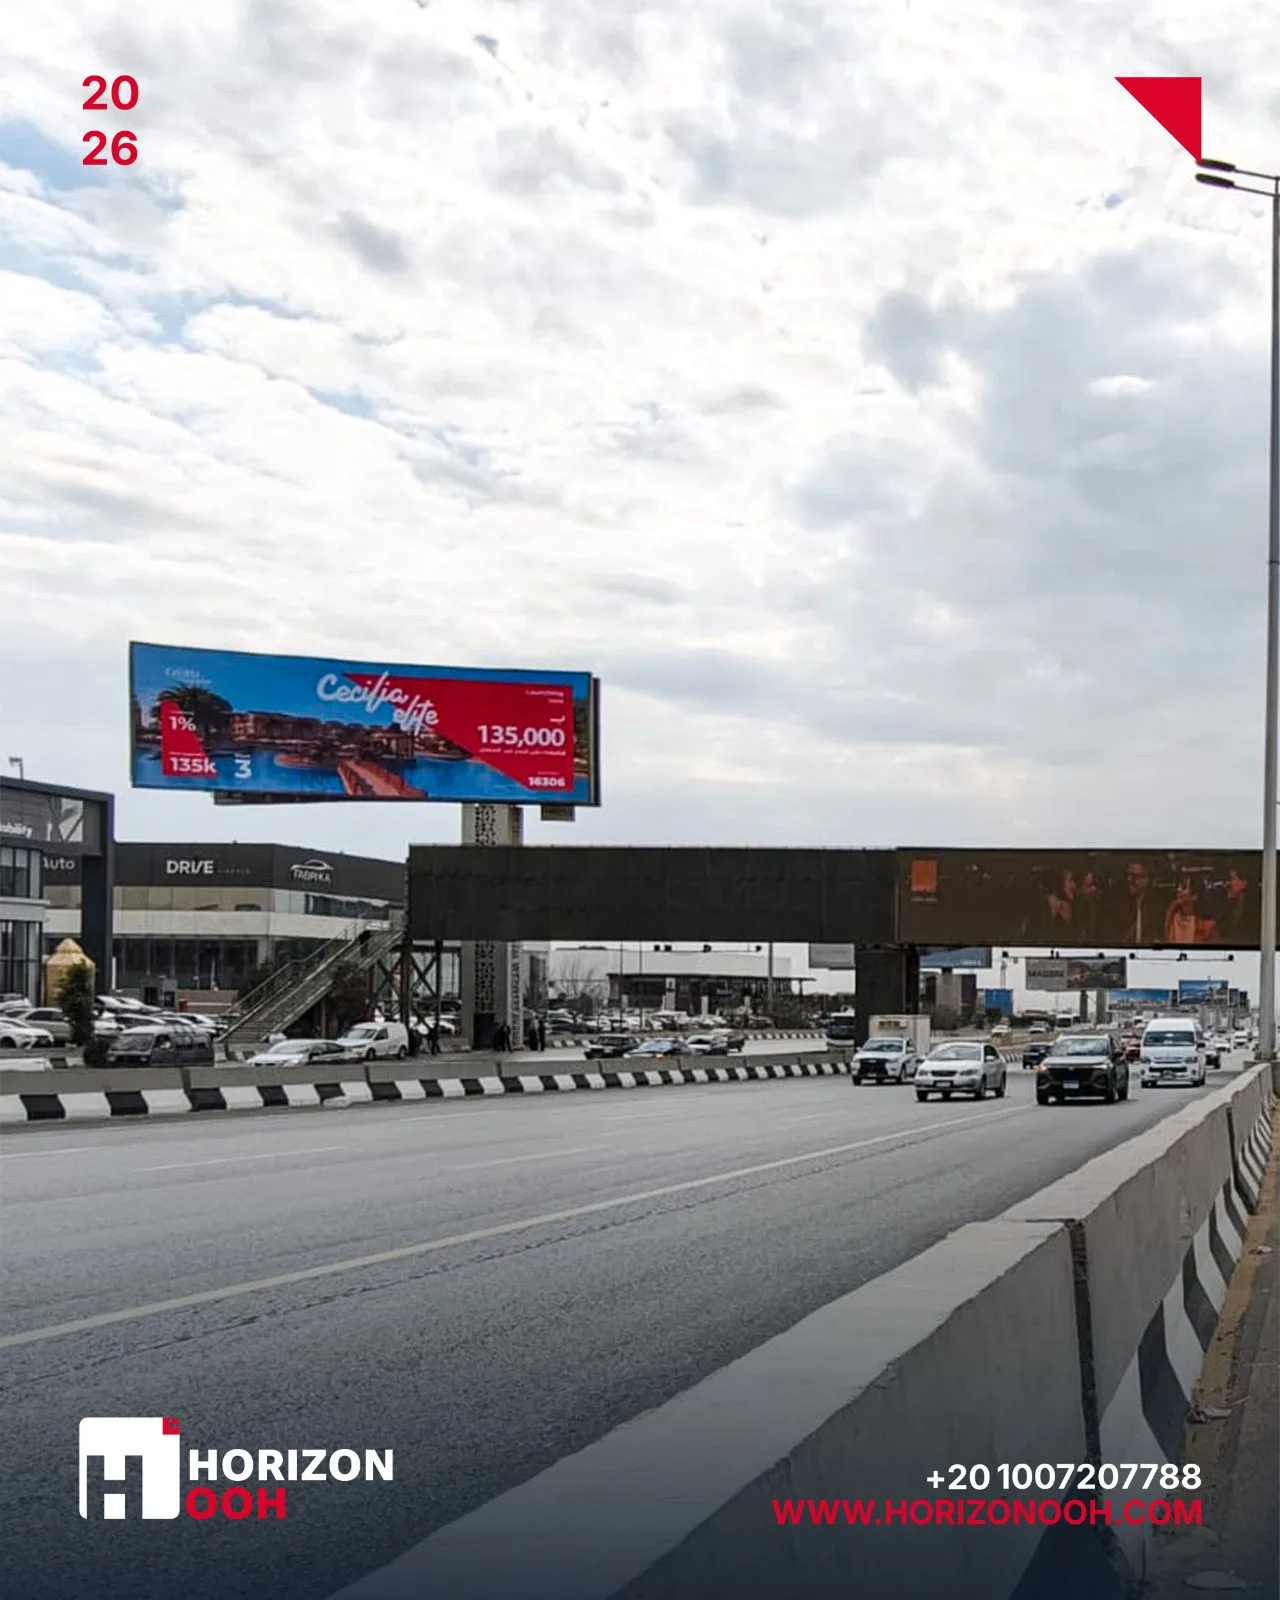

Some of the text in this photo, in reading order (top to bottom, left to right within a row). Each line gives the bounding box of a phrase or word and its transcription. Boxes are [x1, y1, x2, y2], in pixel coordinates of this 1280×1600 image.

[316, 670, 409, 713] Cecilia
[168, 716, 197, 732] 1%
[477, 725, 565, 748] 135,000
[169, 757, 217, 774] 135k
[166, 860, 214, 875] DRIVE
